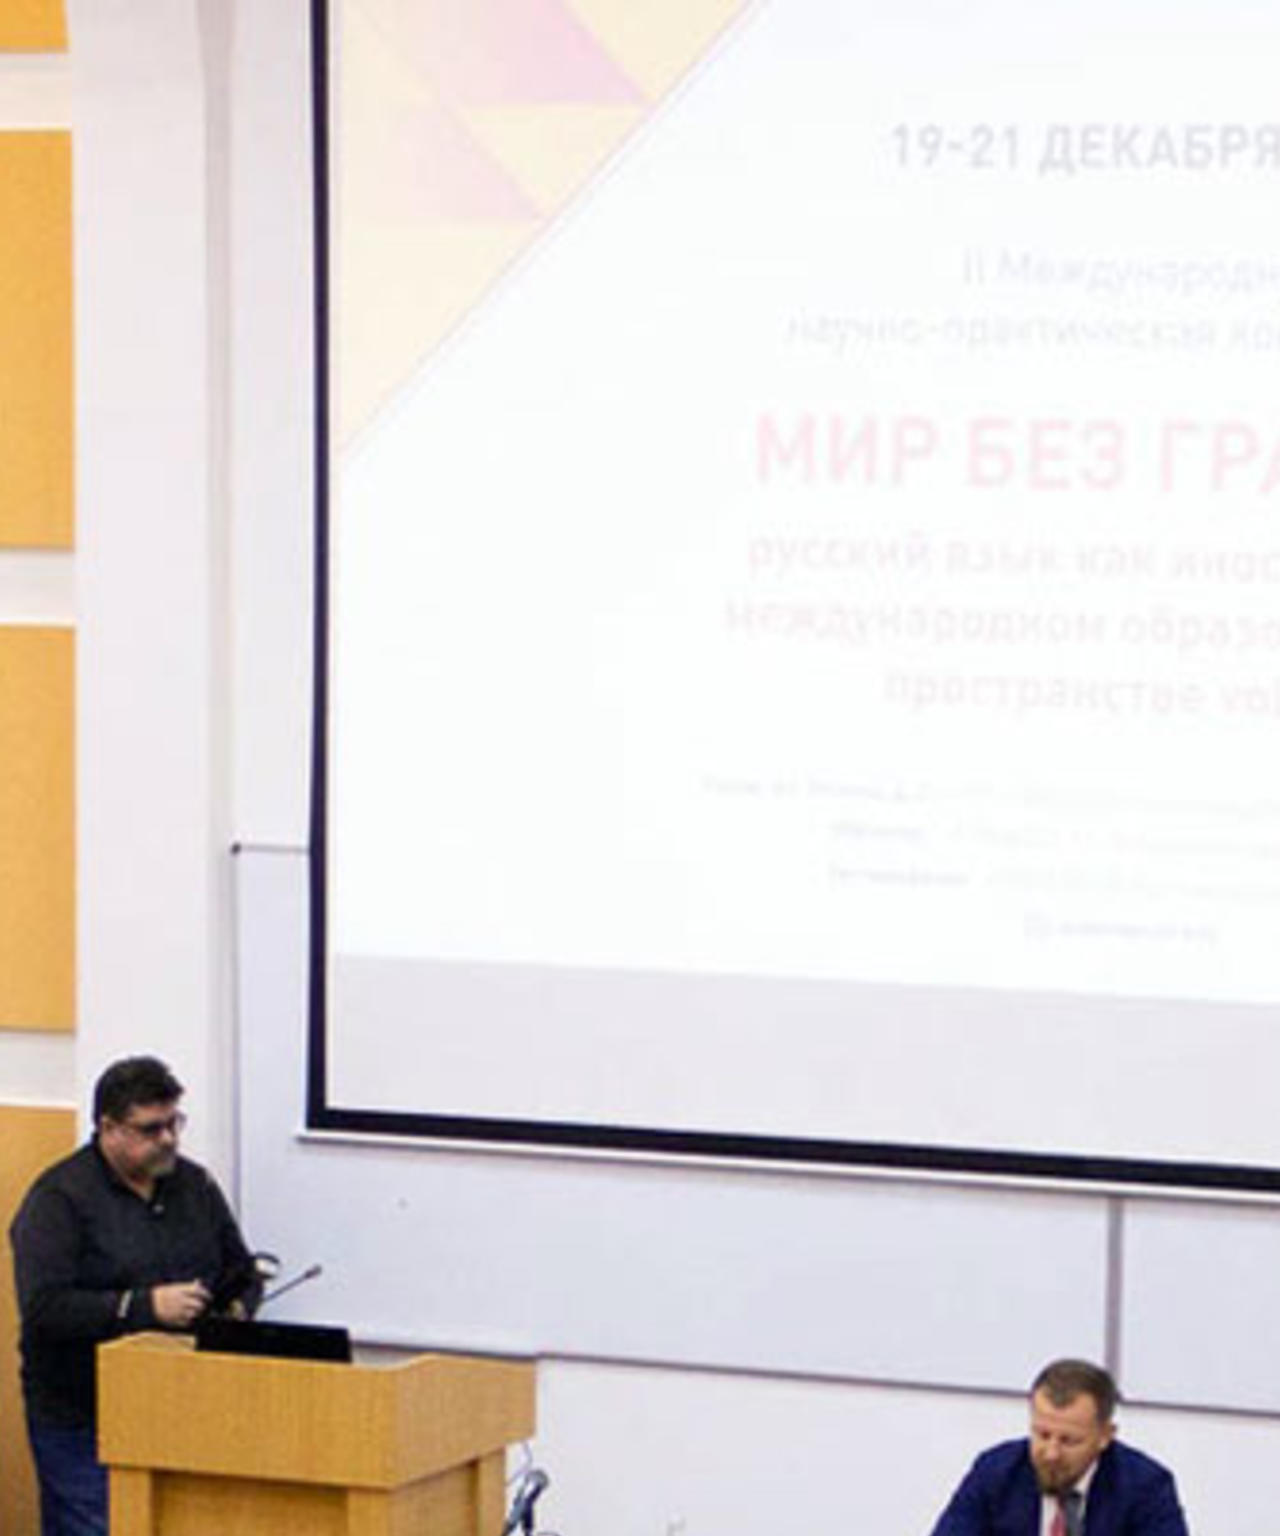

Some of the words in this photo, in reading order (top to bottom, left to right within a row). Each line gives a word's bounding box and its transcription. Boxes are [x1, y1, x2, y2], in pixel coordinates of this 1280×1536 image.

[889, 124, 1021, 171] 19-21
[754, 410, 939, 488] МИР
[966, 416, 1128, 492] БЕЗ
[747, 529, 931, 577] русский
[945, 542, 1063, 577] язык
[1076, 542, 1154, 576] как
